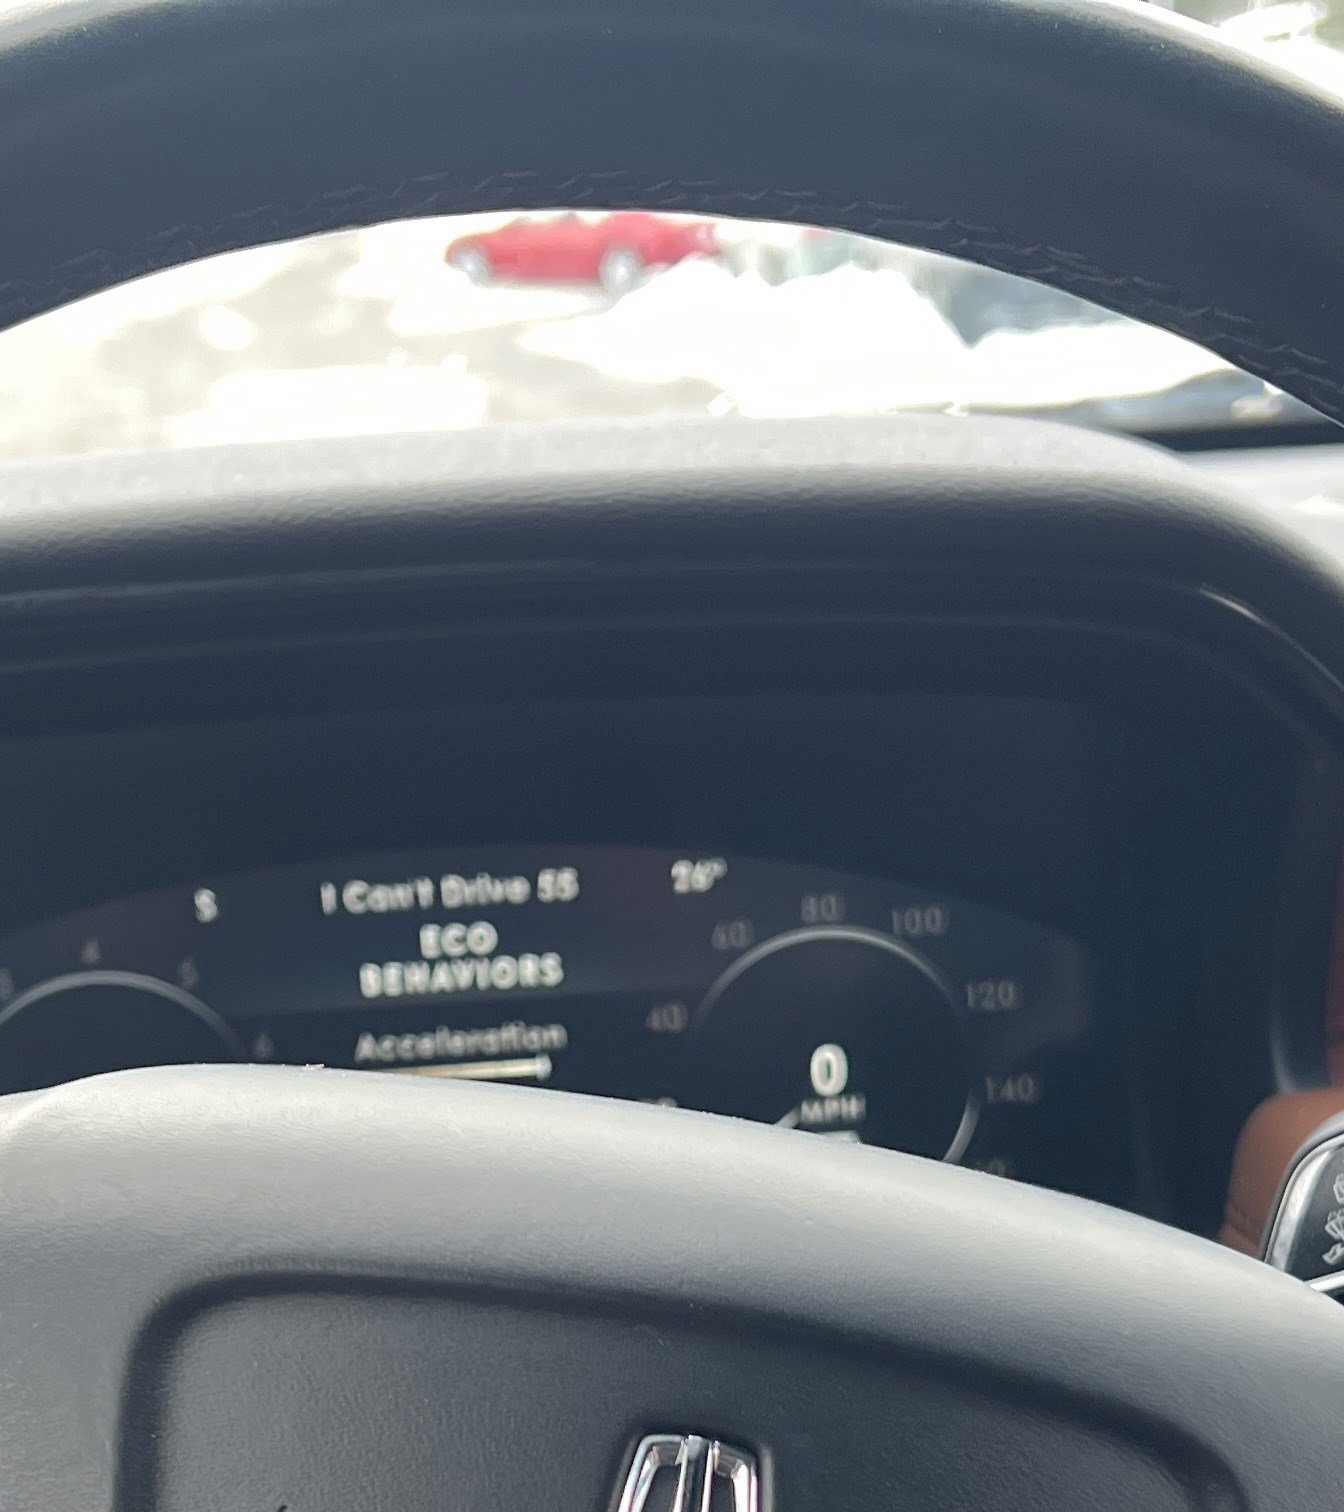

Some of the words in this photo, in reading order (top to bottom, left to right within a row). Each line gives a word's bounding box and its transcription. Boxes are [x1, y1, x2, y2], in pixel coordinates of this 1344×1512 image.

[440, 871, 532, 909] Drive
[419, 920, 499, 960] ECO
[359, 951, 565, 998] BEHAVIORS
[354, 1019, 569, 1062] Acceleration
[800, 1094, 866, 1124] MPH
